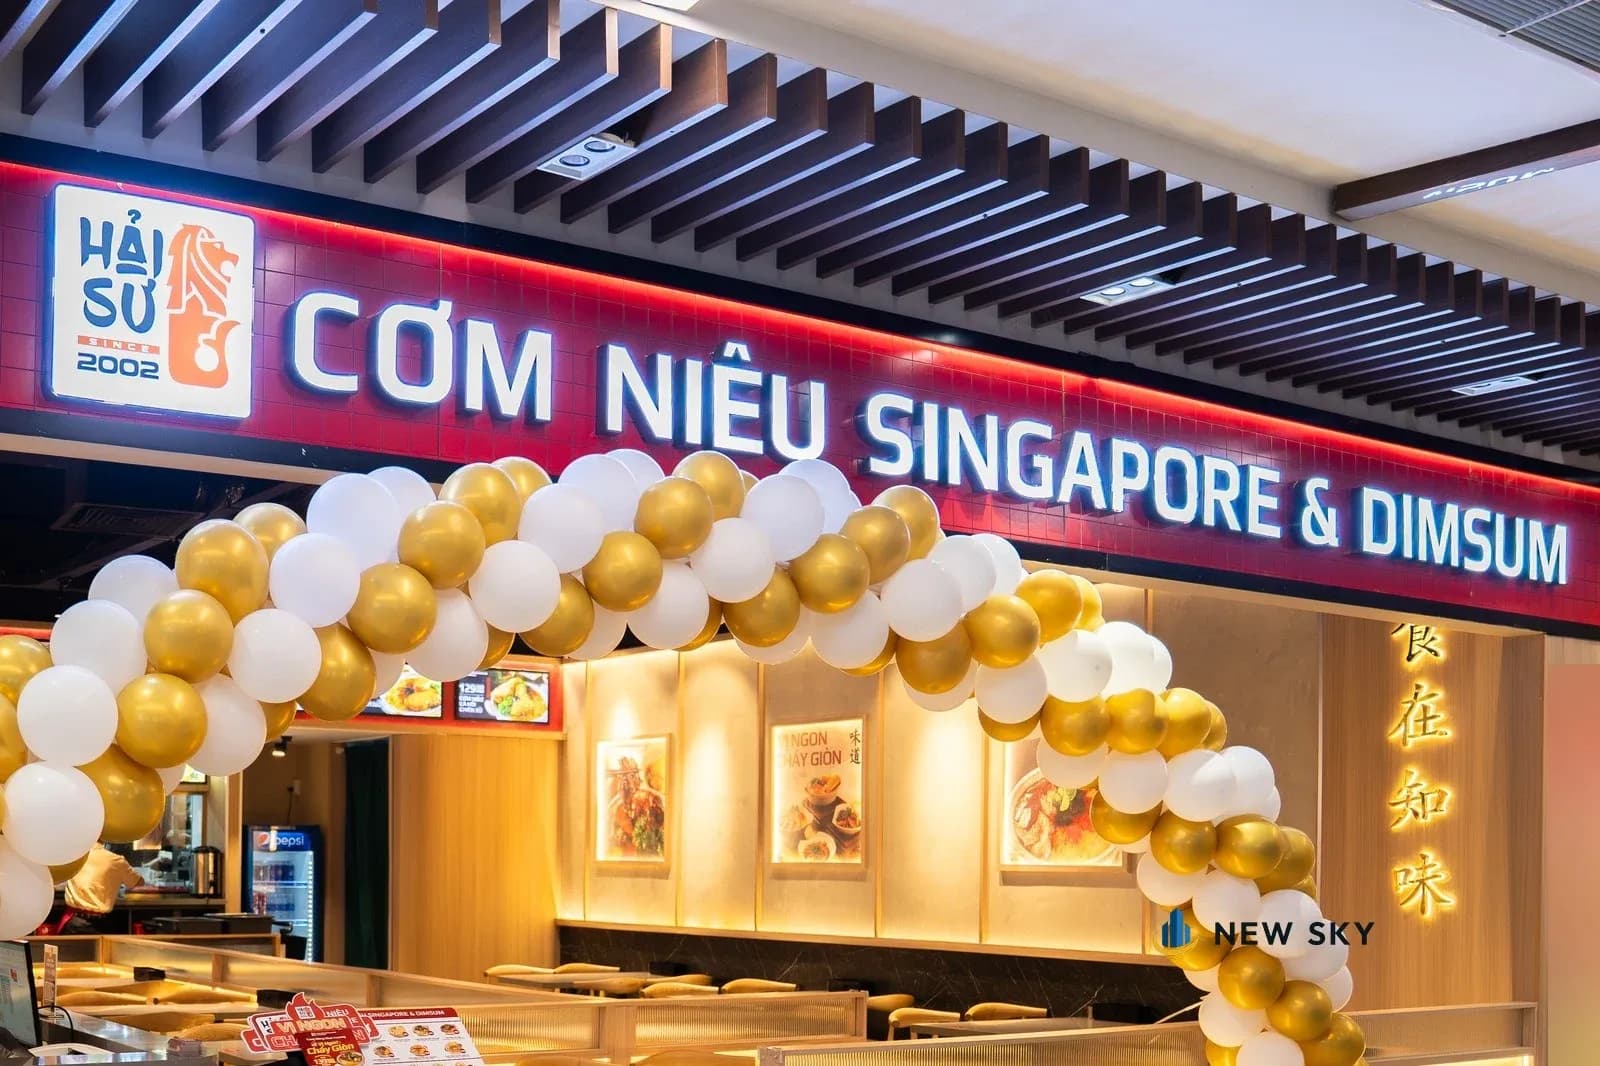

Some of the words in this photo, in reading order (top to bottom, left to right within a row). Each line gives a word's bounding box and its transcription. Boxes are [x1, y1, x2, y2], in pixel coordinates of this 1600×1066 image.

[80, 209, 164, 279] HẢI
[89, 337, 151, 353] SINCE
[77, 352, 159, 380] 2002
[293, 292, 552, 421] CƠM
[606, 341, 825, 460] NIÊU
[866, 393, 1282, 539] SINGAPORE
[1302, 477, 1340, 547] &
[1362, 486, 1568, 585] DIMSUM
[791, 730, 828, 747] NGON
[849, 728, 862, 765] 味道
[275, 836, 305, 848] pepsi
[296, 1017, 347, 1033] NGON
